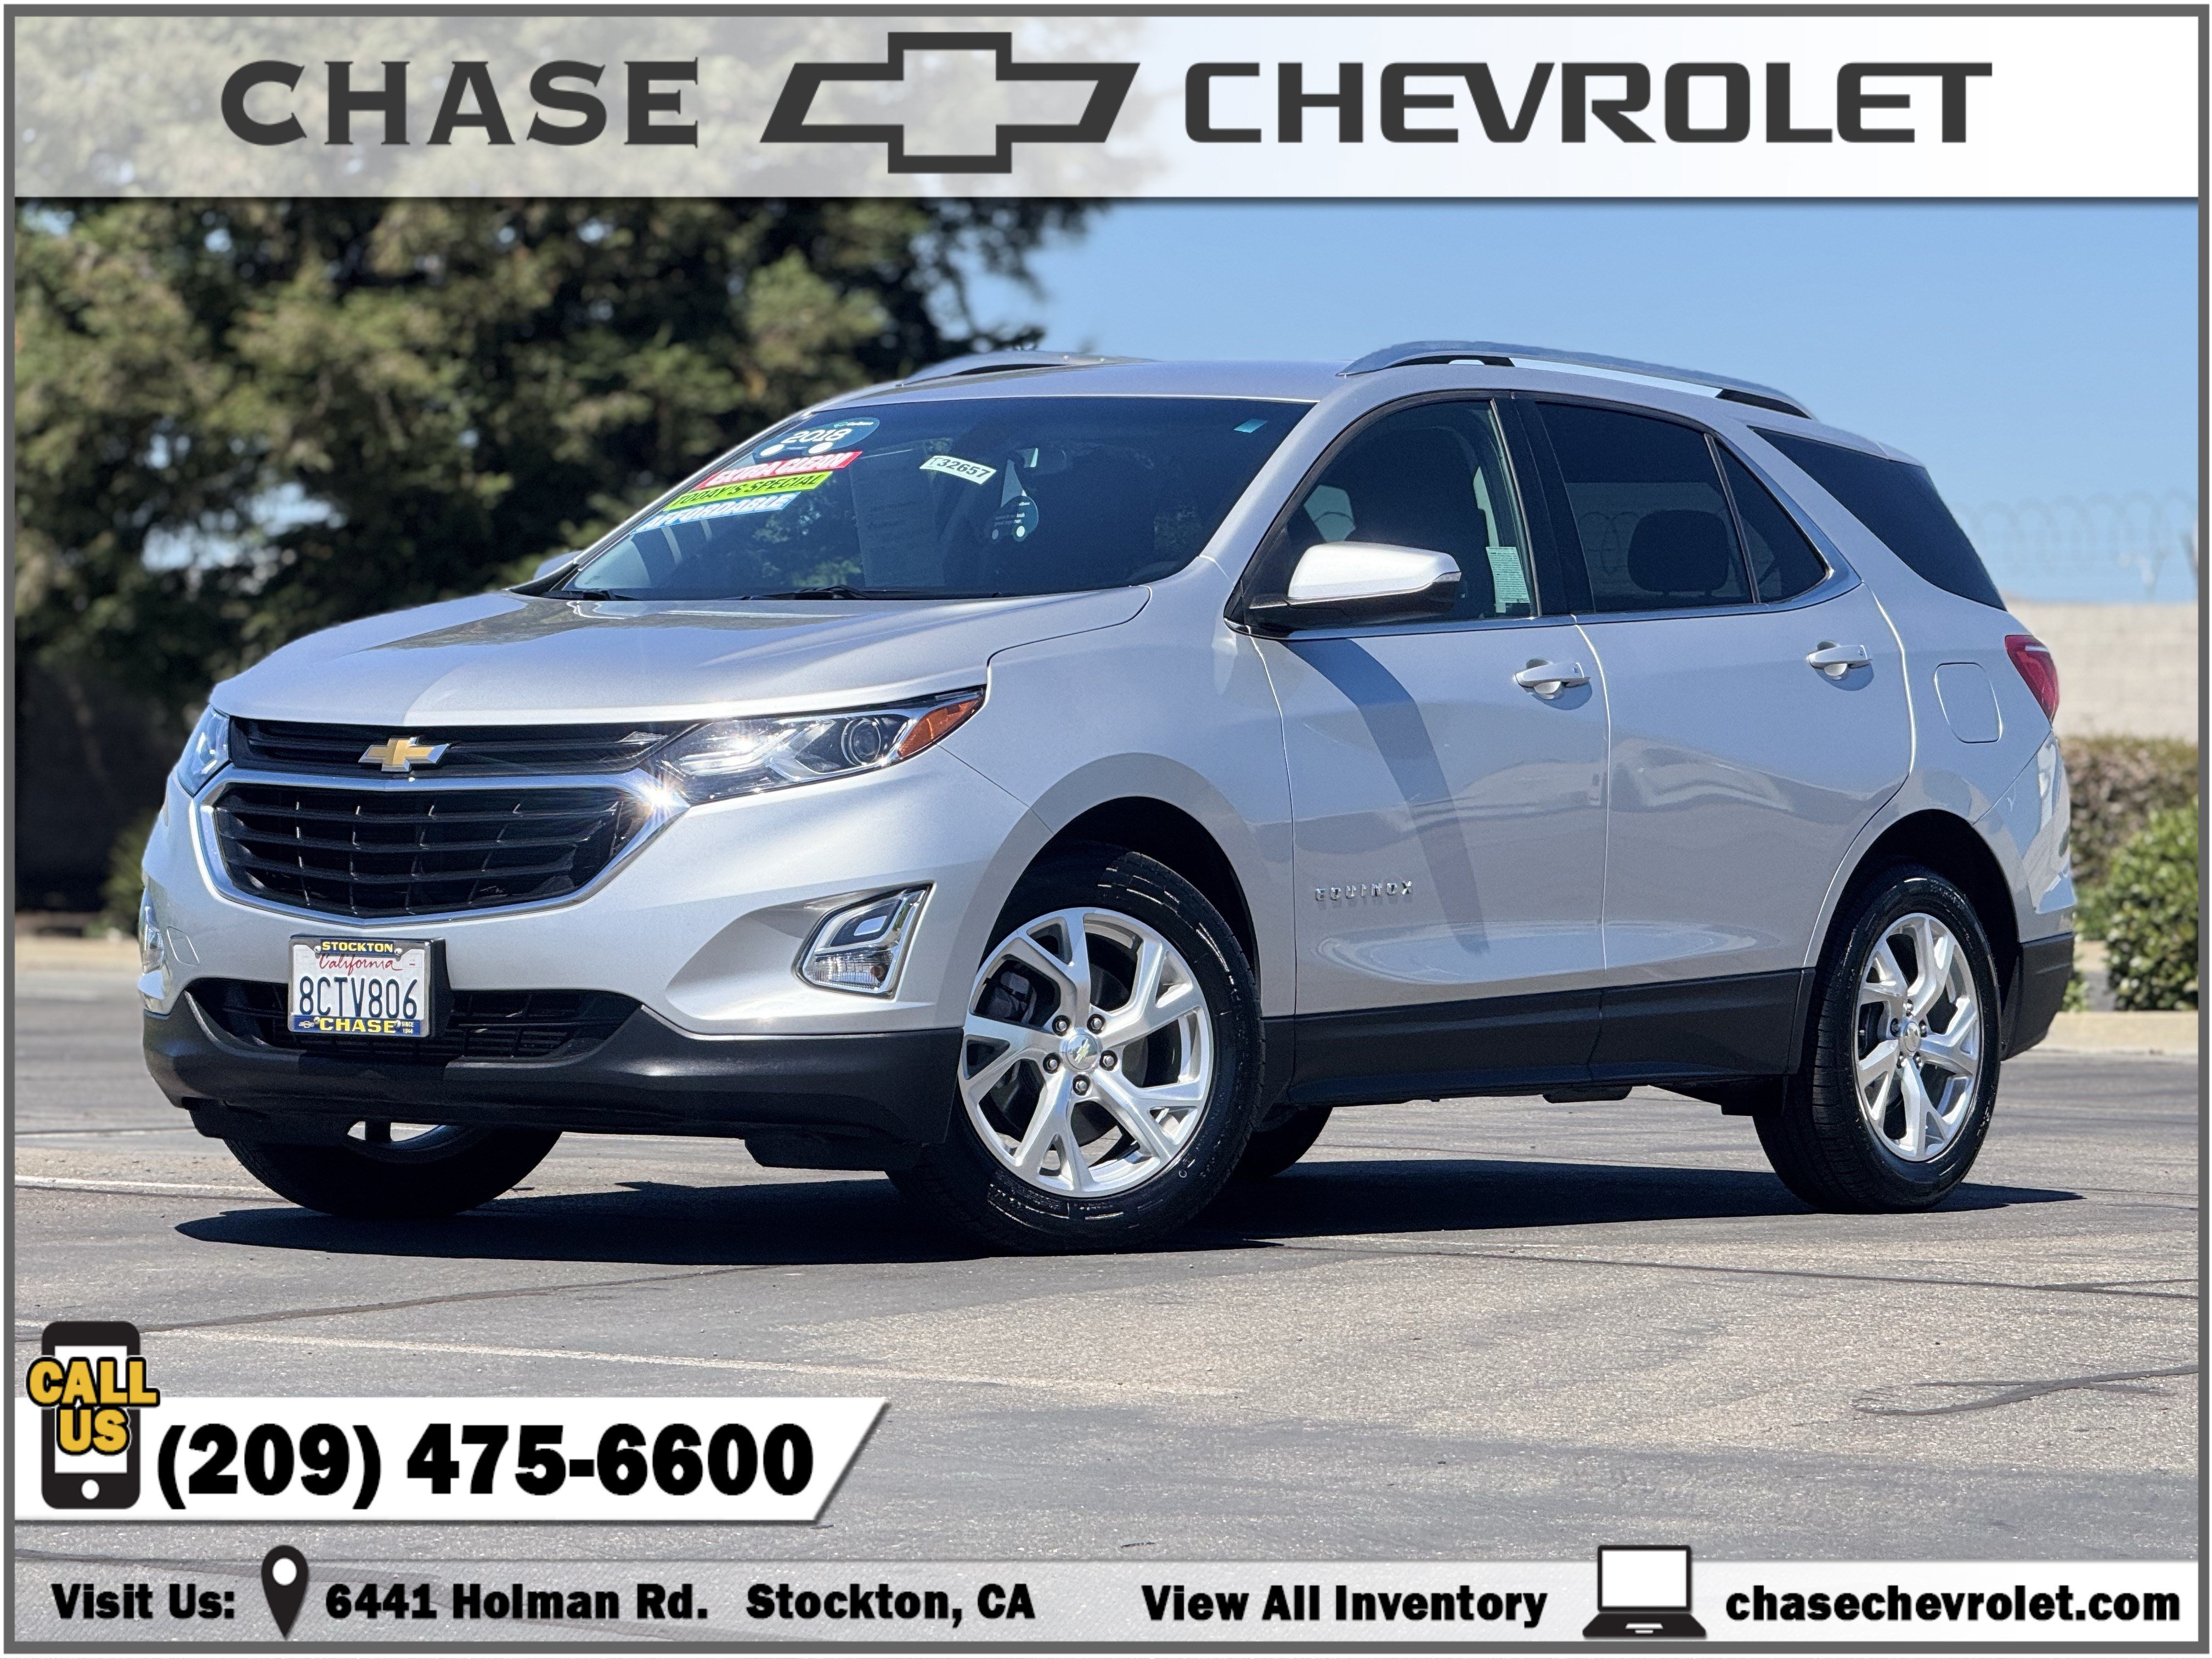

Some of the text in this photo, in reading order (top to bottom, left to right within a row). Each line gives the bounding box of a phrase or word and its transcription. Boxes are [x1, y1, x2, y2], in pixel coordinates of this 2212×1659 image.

[781, 428, 852, 444] 2018
[705, 452, 854, 487] EXTRA CLEAN
[671, 473, 819, 507] TODAY'S SPECIAL
[636, 493, 794, 532] AFFORDABLE
[1314, 880, 1413, 901] EQUINOX
[321, 941, 394, 953] STOCKTON
[319, 952, 403, 976] California
[299, 975, 418, 1019] 8CTV806
[319, 1018, 397, 1034] CHASE
